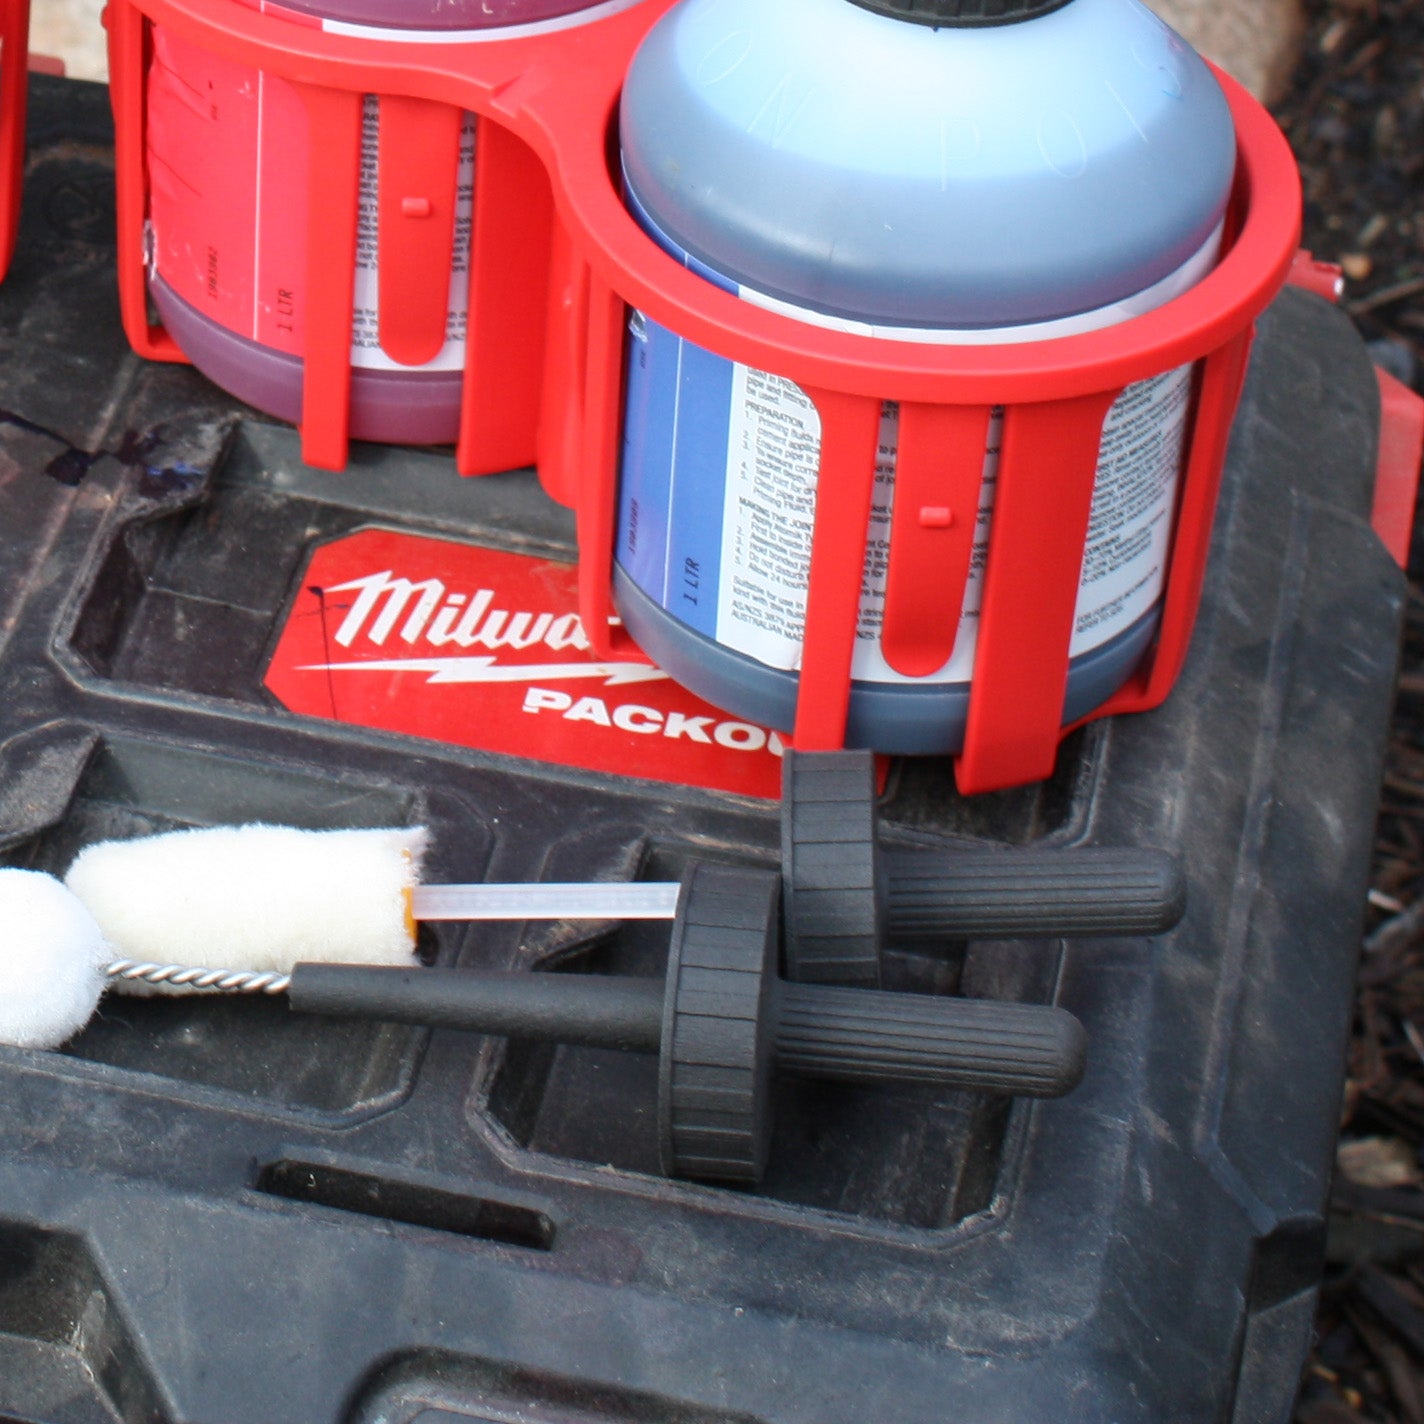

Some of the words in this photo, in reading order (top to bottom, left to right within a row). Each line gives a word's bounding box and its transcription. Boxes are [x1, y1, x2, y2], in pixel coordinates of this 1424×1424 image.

[278, 289, 293, 320] LTR
[278, 323, 293, 332] 1
[746, 376, 764, 389] pipe
[766, 384, 780, 395] and
[746, 385, 756, 396] be
[744, 399, 804, 429] PREPARATION
[756, 426, 786, 446] cement
[758, 415, 789, 436] Priming
[790, 428, 813, 443] fluids
[755, 436, 783, 454] Ensure
[784, 448, 803, 463] pipe
[755, 445, 765, 456] To
[766, 452, 793, 469] ensure
[753, 475, 775, 491] Clean
[776, 488, 794, 502] pipe
[796, 494, 812, 505] and
[755, 465, 771, 479] Test
[790, 482, 802, 494] for
[738, 496, 770, 517] MAKING
[770, 512, 787, 525] THE
[752, 485, 782, 508] Priming
[750, 521, 767, 536] First
[778, 535, 802, 551] inside
[751, 512, 772, 529] Apply
[773, 523, 802, 540] Atomik
[749, 532, 787, 555] Assemble
[749, 541, 767, 555] Hold
[768, 549, 798, 569] bonded
[685, 557, 700, 590] LTR
[747, 562, 768, 578] Allow
[770, 572, 780, 583] 24
[748, 551, 759, 563] Do
[760, 558, 773, 570] not
[774, 565, 804, 581] disturb
[683, 592, 698, 606] 1
[732, 585, 749, 599] kind
[751, 594, 768, 607] with
[769, 602, 784, 614] this
[733, 575, 764, 595] Suitable
[766, 590, 776, 601] for
[778, 596, 793, 608] use
[324, 570, 591, 651] Milwa
[731, 599, 762, 618] AS/NZS
[731, 610, 782, 635] AUSTRALIAN
